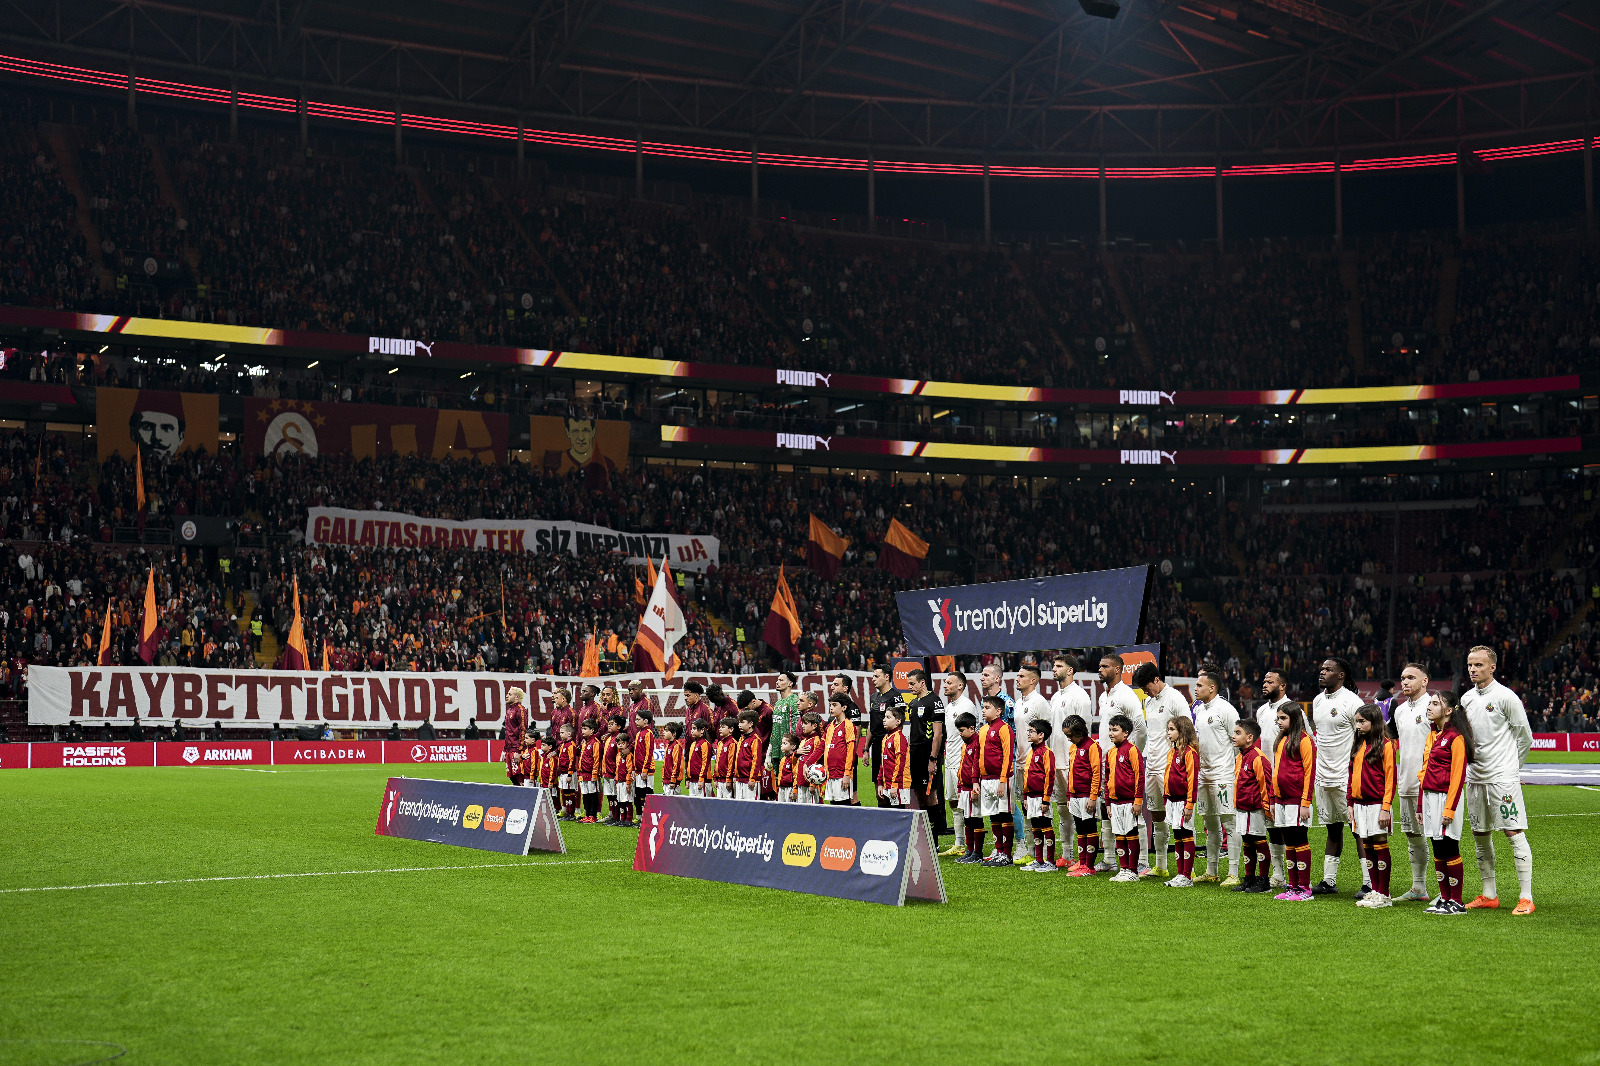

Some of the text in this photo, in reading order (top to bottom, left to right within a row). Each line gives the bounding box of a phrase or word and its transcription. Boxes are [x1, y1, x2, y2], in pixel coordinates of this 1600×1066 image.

[369, 337, 416, 356] PUMA
[777, 369, 816, 386] PUMA
[1120, 390, 1160, 404] PUMA
[777, 433, 816, 449] PUMA
[1121, 450, 1161, 464] PUMA
[314, 516, 478, 551] GALATASARAY
[483, 529, 525, 553] TEK
[955, 598, 1035, 634] trendyol
[429, 745, 467, 754] TURKISH
[1531, 739, 1556, 749] RKHAM
[204, 749, 252, 761] ARKHAM
[294, 749, 366, 759] ACIBADEM
[430, 752, 468, 761] AIRLINES
[1217, 790, 1228, 804] 11
[399, 797, 433, 821] trendyol
[1500, 802, 1518, 819] 94
[669, 821, 726, 853] trendyol
[824, 845, 854, 861] trendyol
